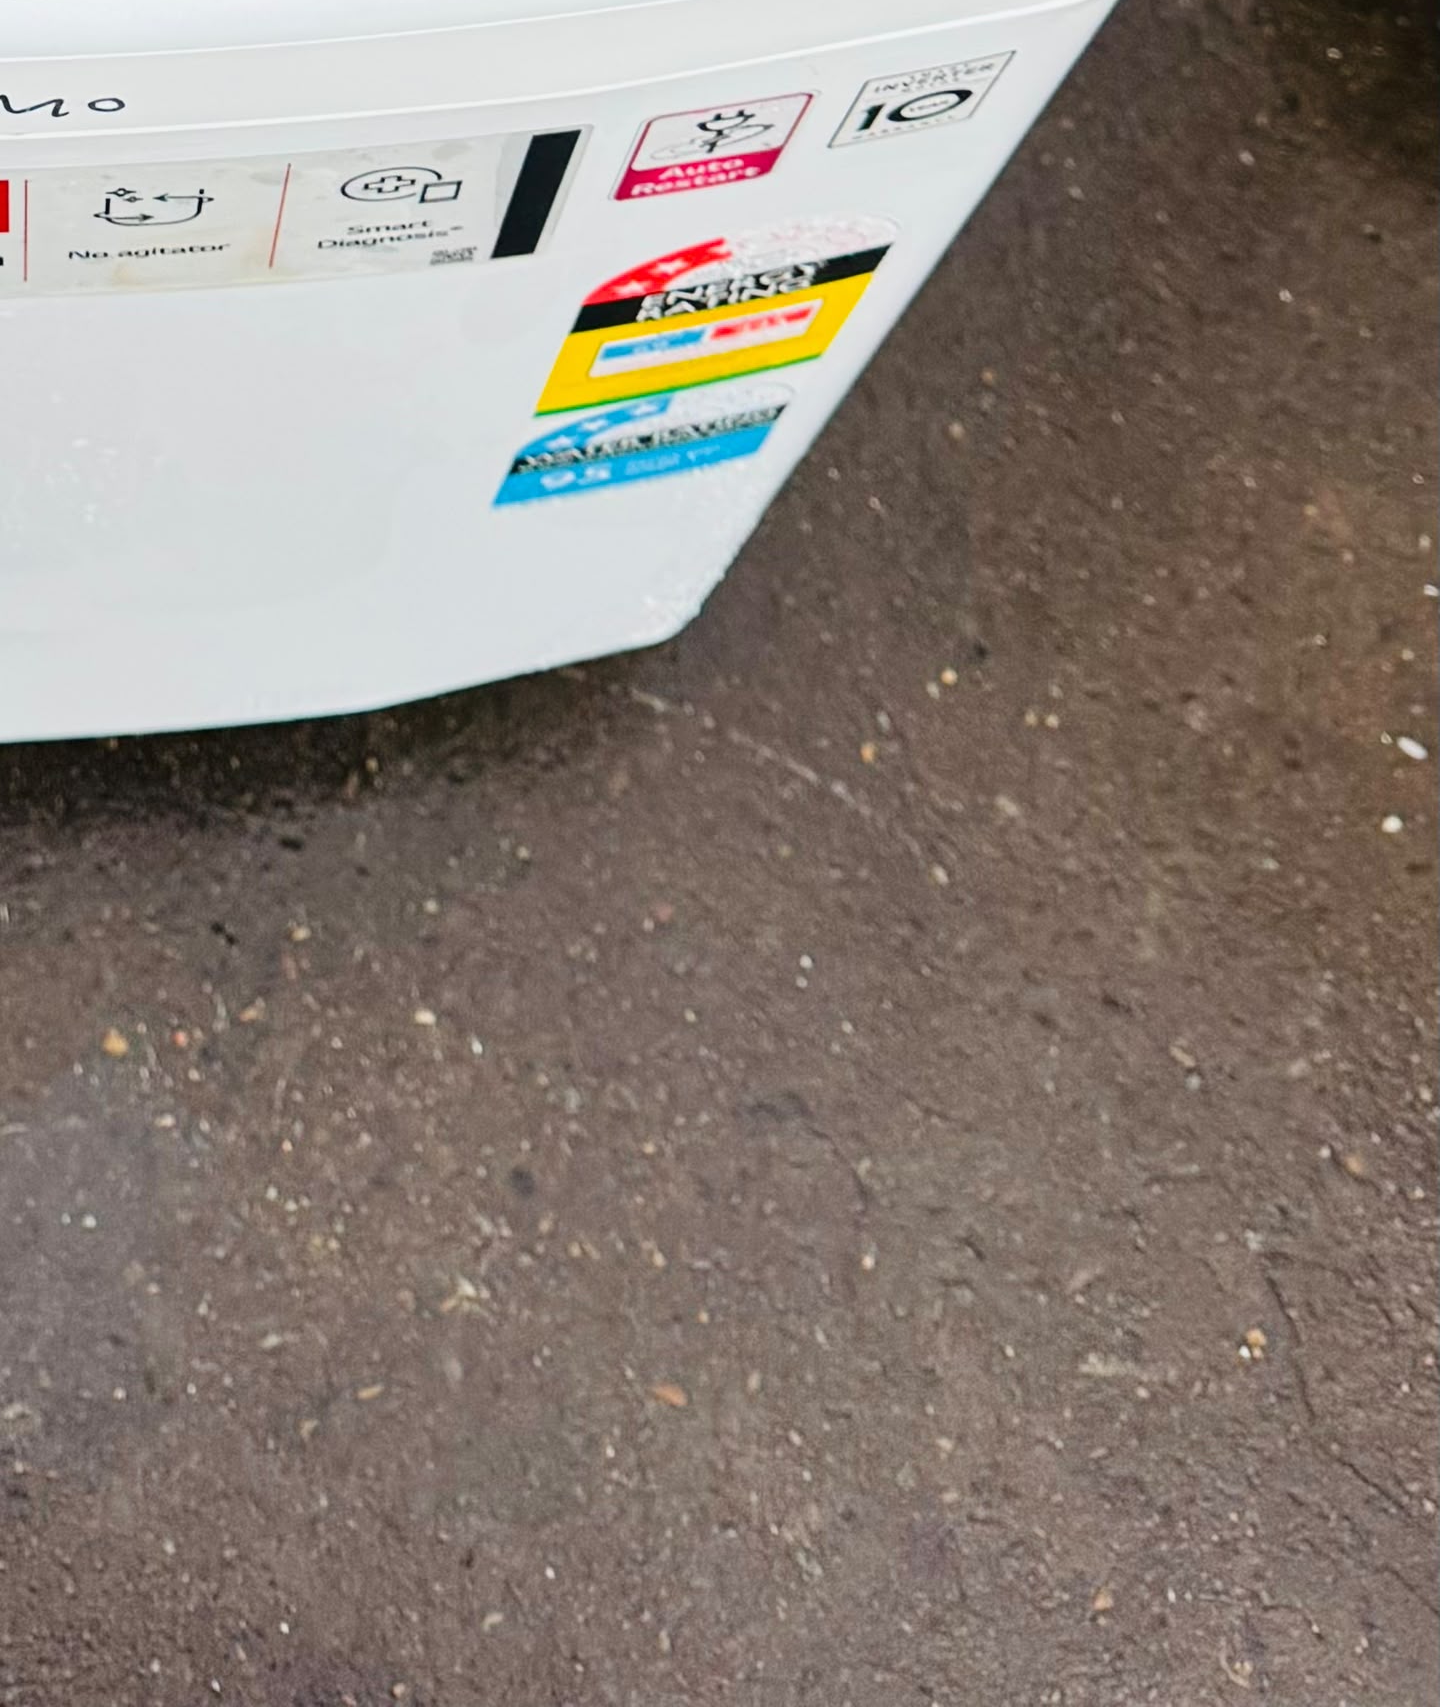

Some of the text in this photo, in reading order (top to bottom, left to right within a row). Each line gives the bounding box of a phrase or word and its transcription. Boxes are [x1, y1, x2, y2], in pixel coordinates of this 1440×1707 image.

[857, 89, 974, 133] 10
[658, 157, 745, 181] Auto
[630, 166, 761, 197] Restart
[346, 220, 432, 235] Smart
[68, 243, 231, 260] No agitator
